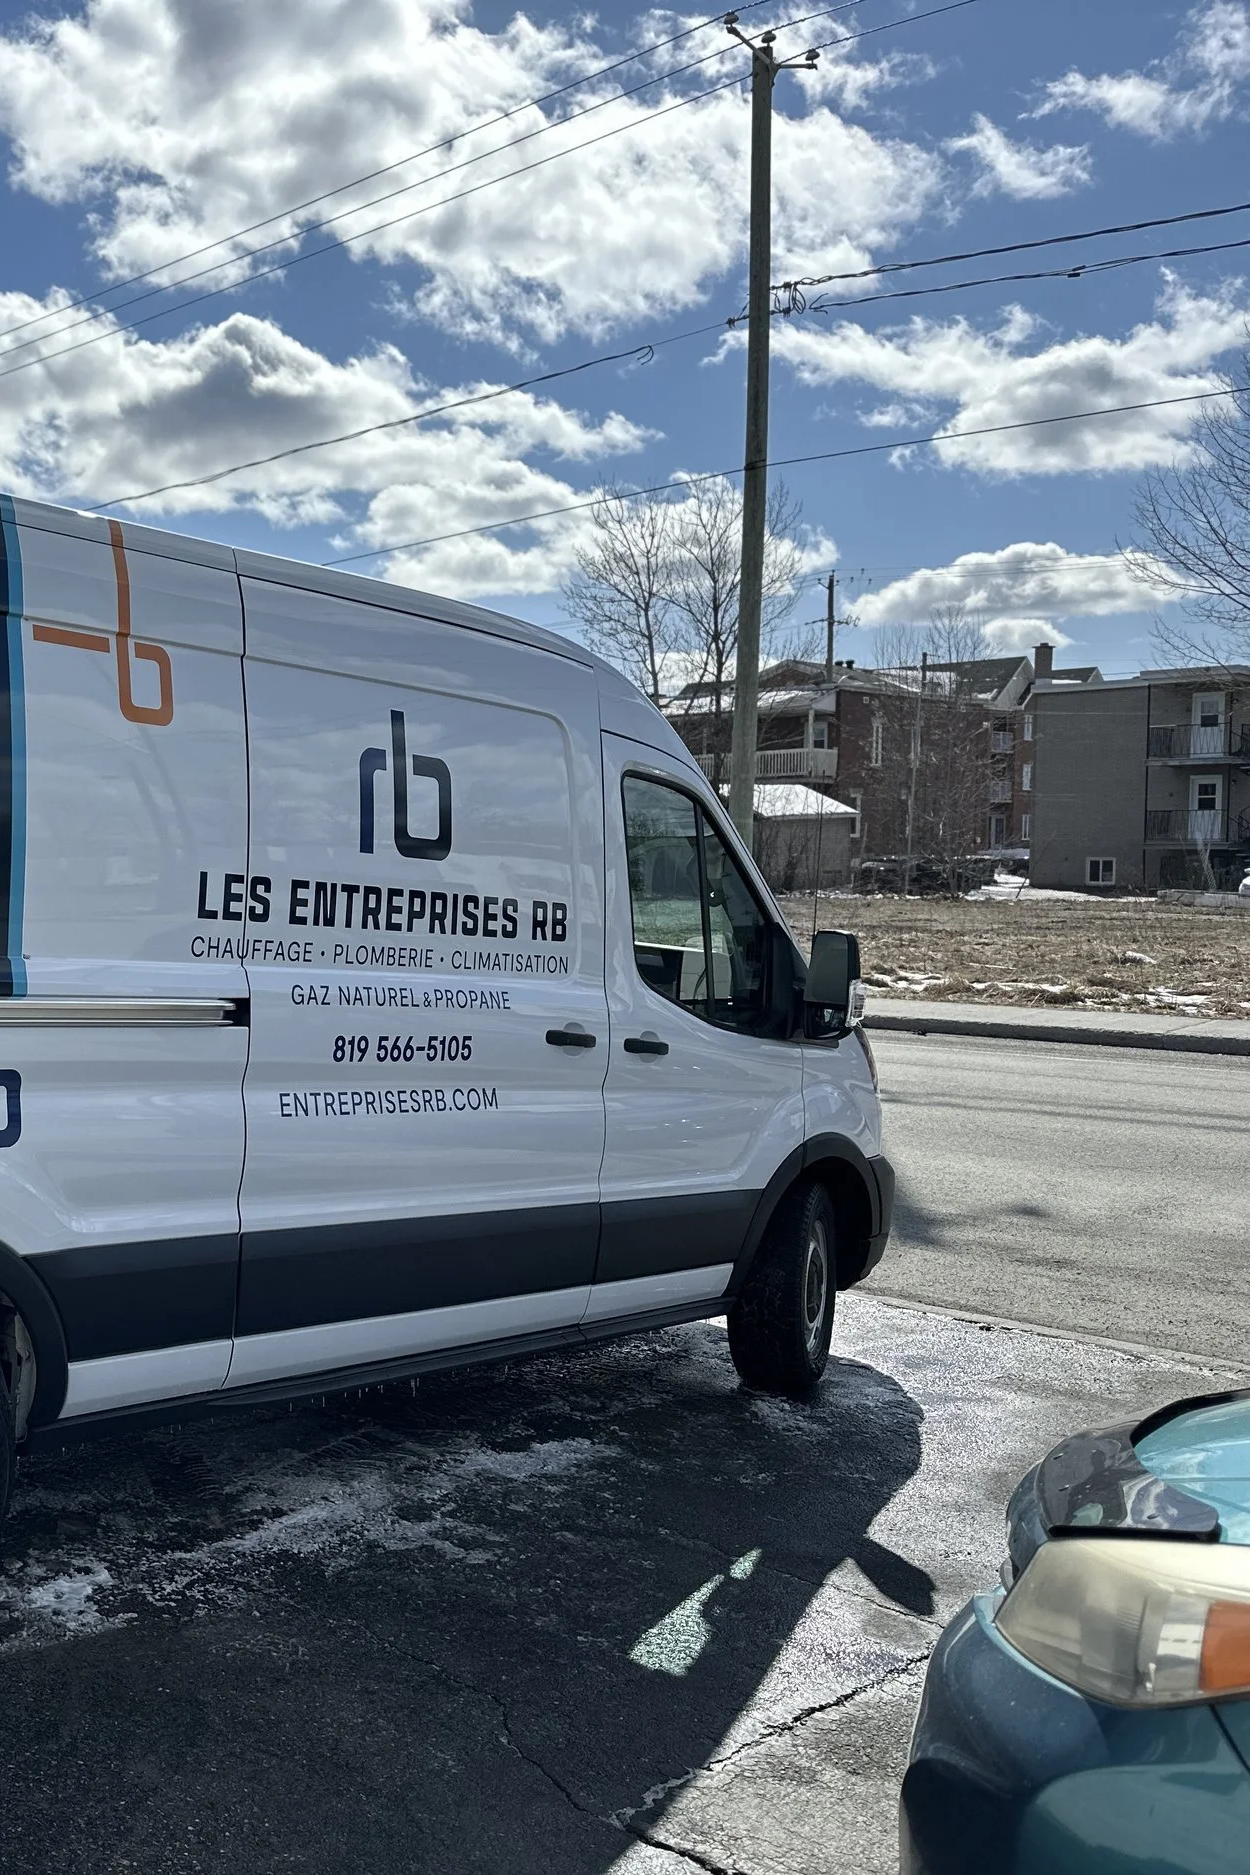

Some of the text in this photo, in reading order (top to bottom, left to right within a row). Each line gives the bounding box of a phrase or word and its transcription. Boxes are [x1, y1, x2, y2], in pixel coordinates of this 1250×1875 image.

[359, 709, 453, 862] rb
[196, 870, 568, 942] LES ENTREPRISES RB
[190, 935, 569, 975] CHAUFFAGE PLOMBERIE CLIMATISATION
[290, 984, 332, 1006] GAZ
[332, 1035, 473, 1063] 819 566-5105
[278, 1087, 499, 1118] ENTREPRISESRB.COM
